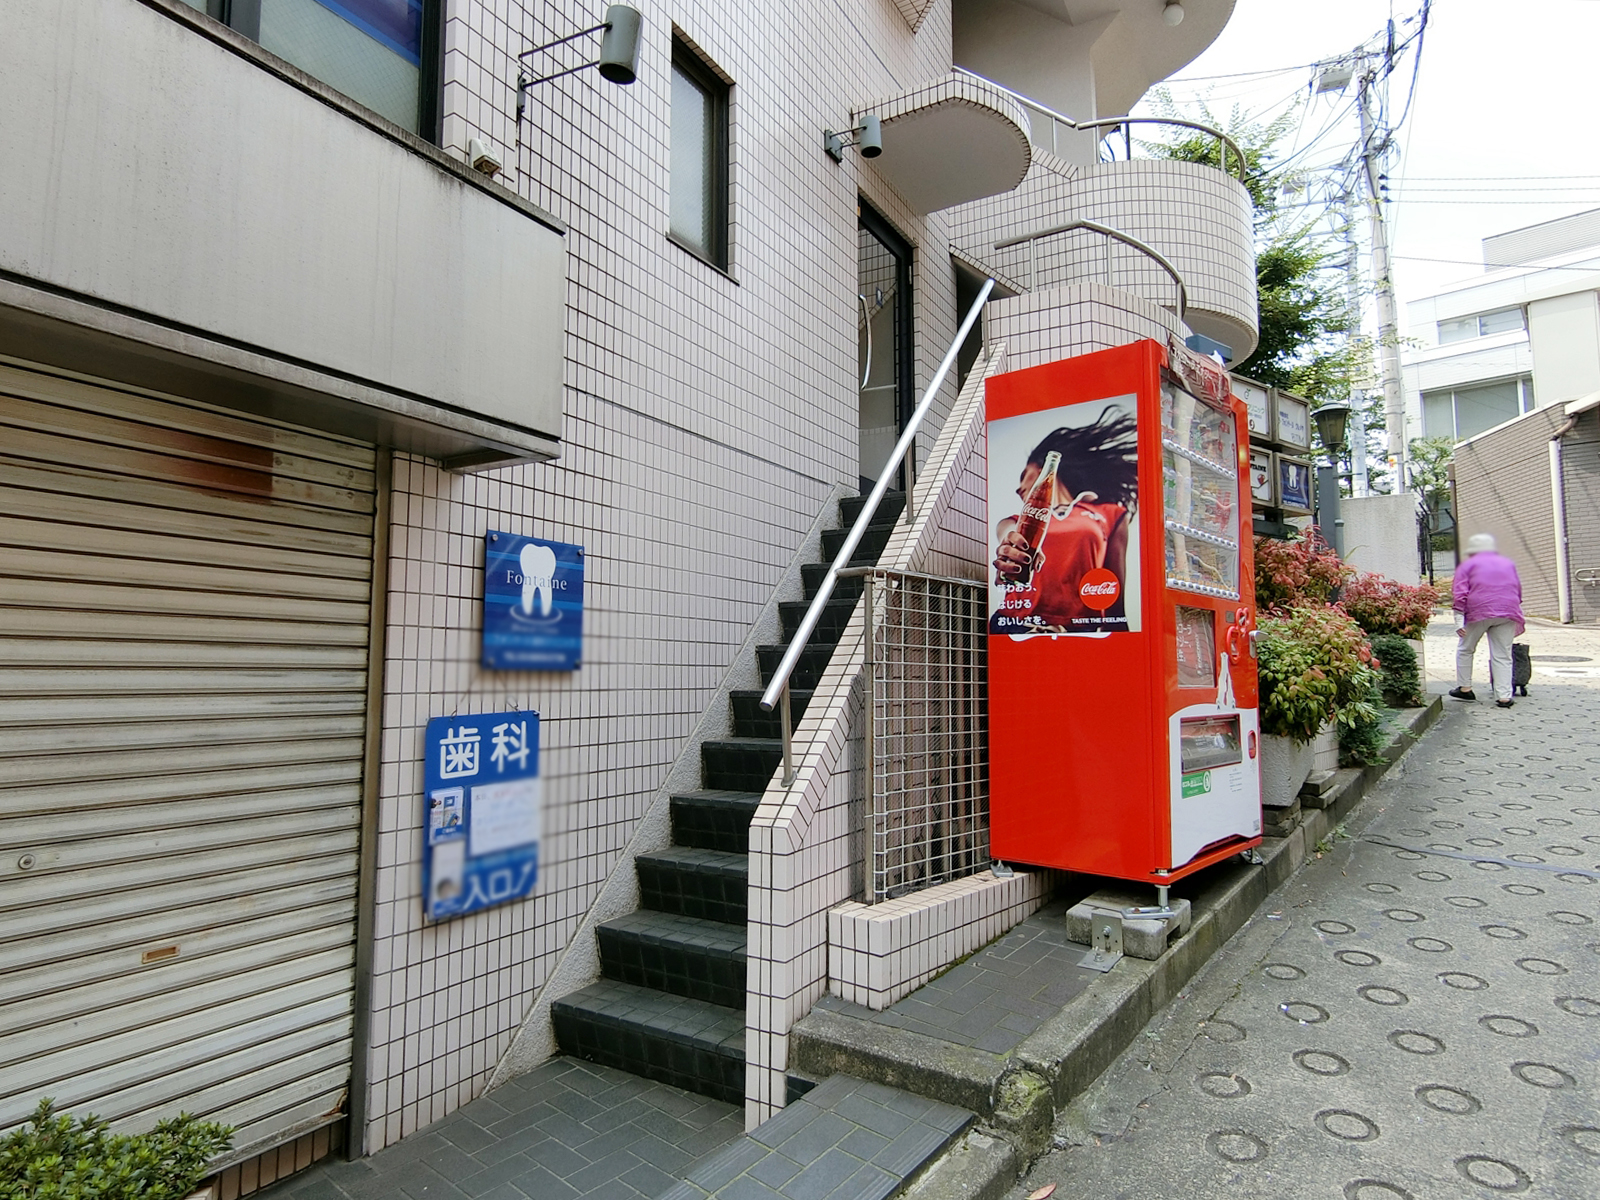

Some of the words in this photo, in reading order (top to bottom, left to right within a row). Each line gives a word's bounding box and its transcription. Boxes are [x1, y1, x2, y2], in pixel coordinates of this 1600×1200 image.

[506, 569, 568, 591] Fontaine
[1080, 581, 1118, 596] Coca-Cola
[997, 615, 1046, 626] おいしさを。
[439, 720, 530, 780] 歯科
[462, 868, 513, 911] 入口
